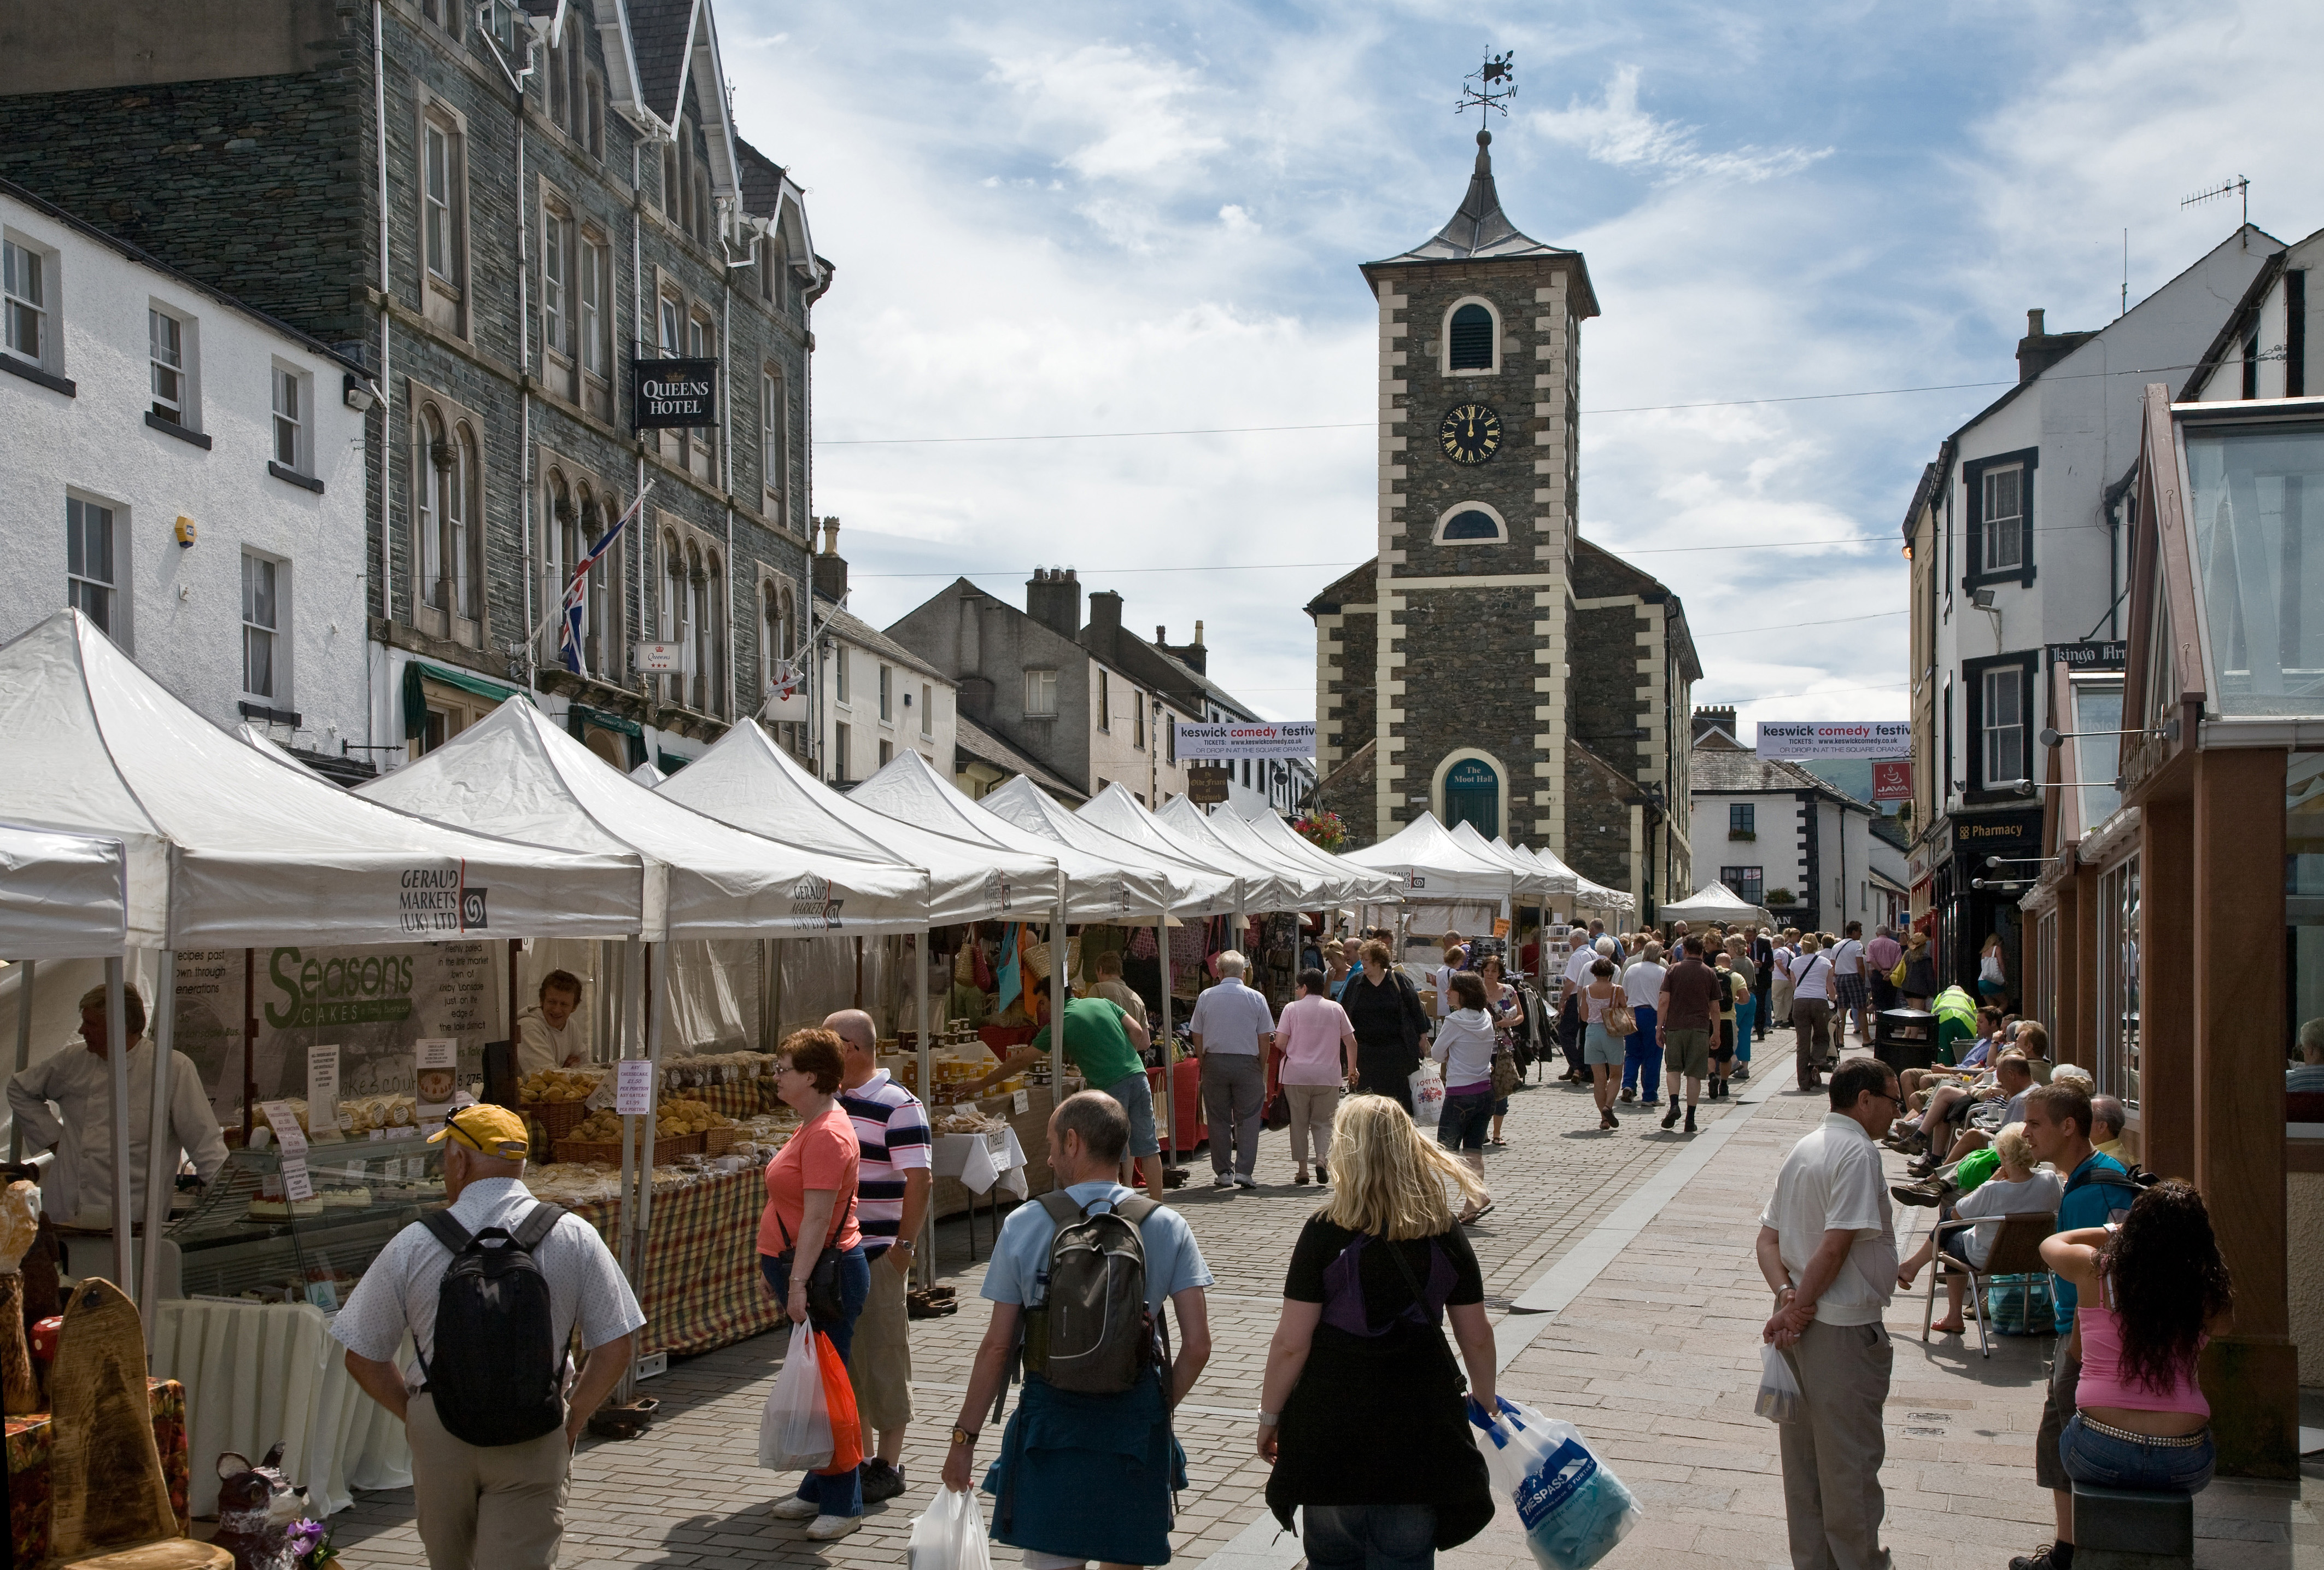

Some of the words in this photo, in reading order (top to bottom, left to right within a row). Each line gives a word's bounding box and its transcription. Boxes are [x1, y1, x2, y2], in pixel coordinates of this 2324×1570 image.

[1508, 85, 1518, 98] W
[643, 380, 708, 400] QUEENS
[651, 401, 701, 415] HOTEL
[648, 653, 670, 661] Queens
[1181, 727, 1227, 737] keswick
[1231, 726, 1277, 739] comedy
[1282, 725, 1316, 736] festiv
[1764, 725, 1814, 736] keswick
[1818, 725, 1870, 738] comedy
[1205, 779, 1226, 787] Friars
[1972, 824, 2022, 837] Pharmacy
[401, 869, 458, 888] GERAUD
[985, 875, 1001, 888] GERAUD
[794, 885, 827, 900] GERAUD
[984, 888, 1001, 900] MARKETS
[400, 891, 456, 909] MARKETS
[790, 902, 826, 914] MARKETS
[400, 913, 429, 934] (UK)
[435, 913, 457, 930] LTD
[792, 917, 809, 931] (UK)
[810, 917, 825, 929] LTD
[177, 950, 204, 962] ecipes
[208, 949, 225, 962] past
[446, 945, 464, 954] Freshly
[468, 956, 488, 965] market
[195, 966, 225, 979] through
[467, 970, 474, 978] of
[175, 983, 219, 994] enerations
[265, 947, 413, 1029] Seasons
[439, 984, 455, 993] Kirkby
[444, 996, 456, 1007] just
[302, 1005, 358, 1024] CAKES
[384, 1003, 409, 1013] business
[452, 1010, 467, 1019] edge
[467, 1021, 485, 1029] district
[990, 1131, 1005, 1147] TABLET
[1573, 1460, 1594, 1485] FURTHER
[1522, 1474, 1567, 1515] TRESPASS
[1566, 1491, 1585, 1510] OUTDOOR
